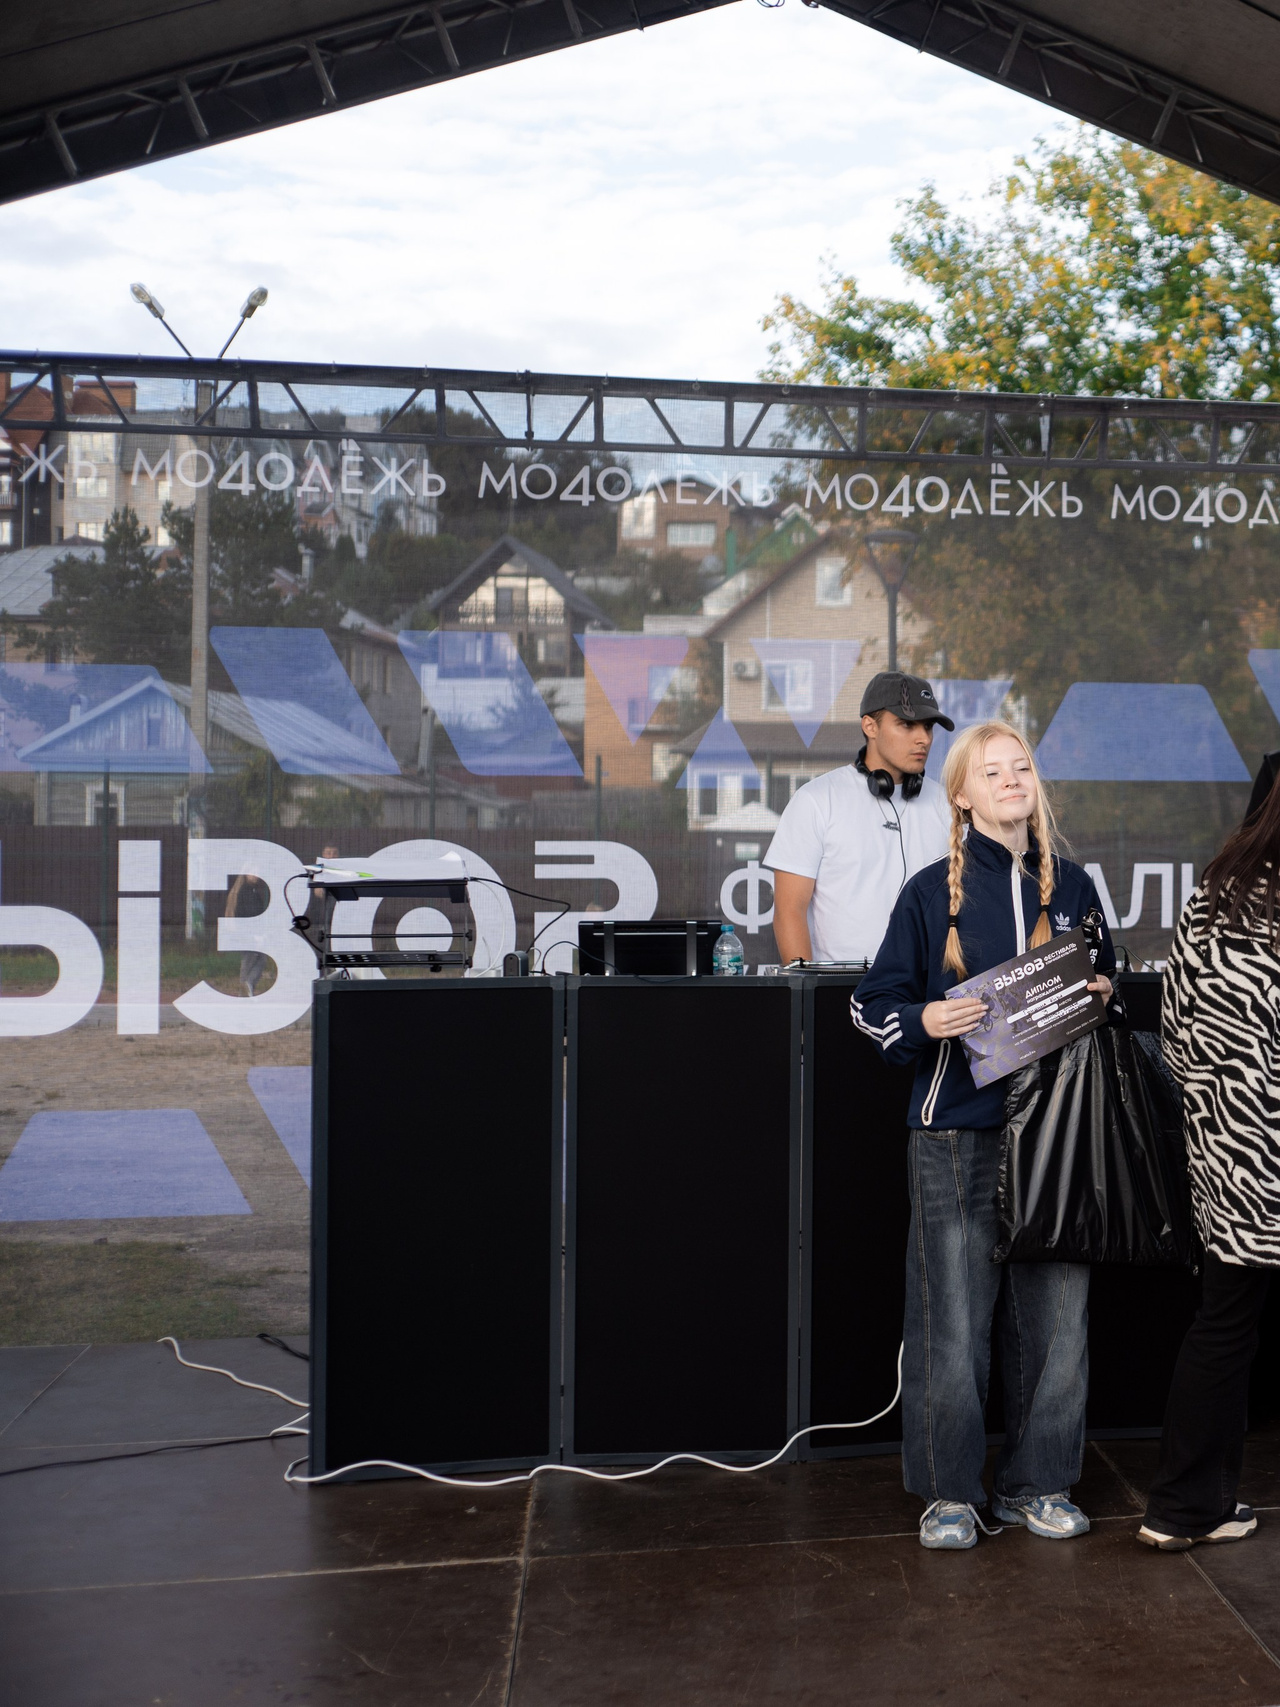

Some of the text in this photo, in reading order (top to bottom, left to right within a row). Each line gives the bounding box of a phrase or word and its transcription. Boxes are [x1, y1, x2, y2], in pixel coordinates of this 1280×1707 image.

[993, 957, 1045, 991] ВЫЗОВ
[1043, 942, 1077, 962] ФЕСТИВАЛЬ
[1025, 975, 1062, 1000] ДИПЛОМ
